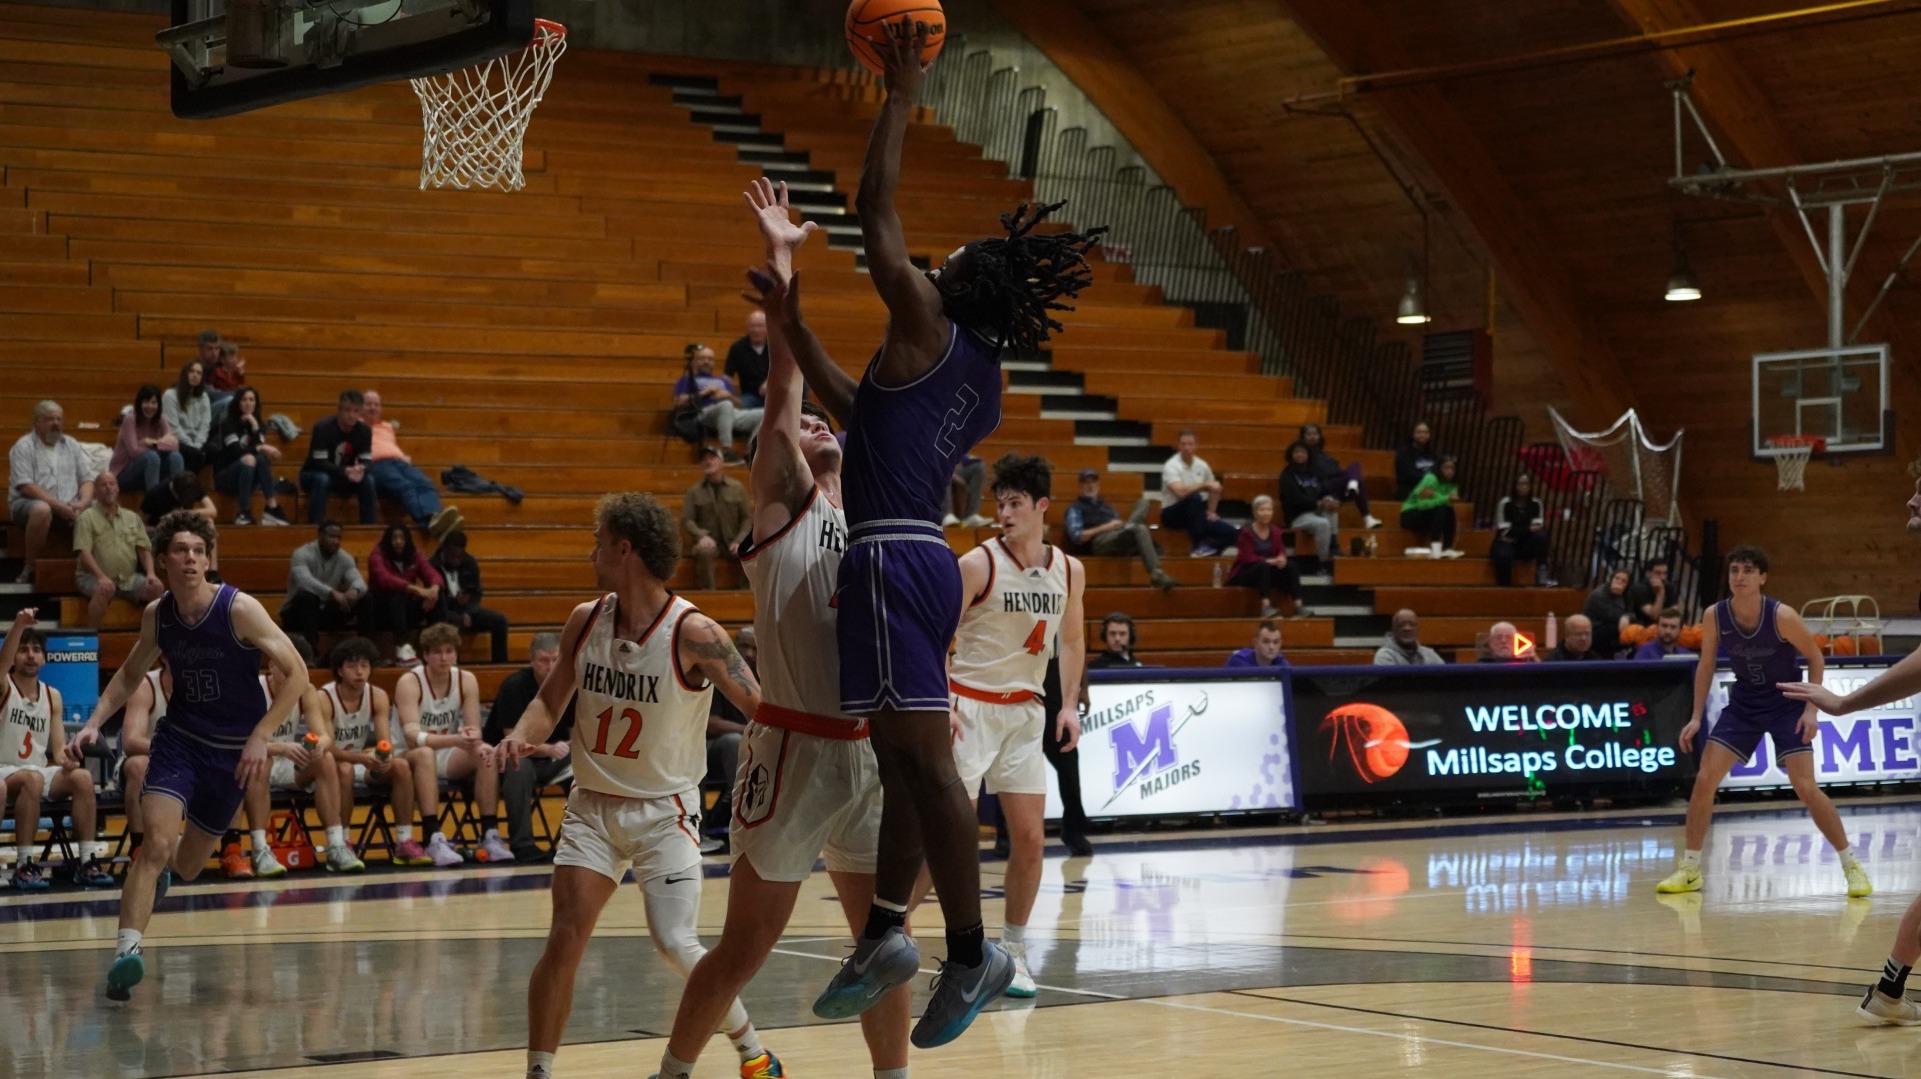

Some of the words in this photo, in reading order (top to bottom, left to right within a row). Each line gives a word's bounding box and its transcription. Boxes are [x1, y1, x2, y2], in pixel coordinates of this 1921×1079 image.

[933, 383, 980, 459] 2
[1022, 619, 1048, 656] 4
[46, 651, 98, 662] POWERADE
[1747, 663, 1767, 686] 5
[181, 668, 221, 703] 33
[582, 661, 660, 704] HENDRIX
[1080, 688, 1156, 736] MILLSAPS
[1464, 702, 1632, 733] WELCOME
[591, 705, 643, 760] 12
[1426, 746, 1558, 778] Millsaps
[1564, 741, 1676, 773] College
[1139, 758, 1202, 800] MAJORS
[287, 850, 299, 866] G
